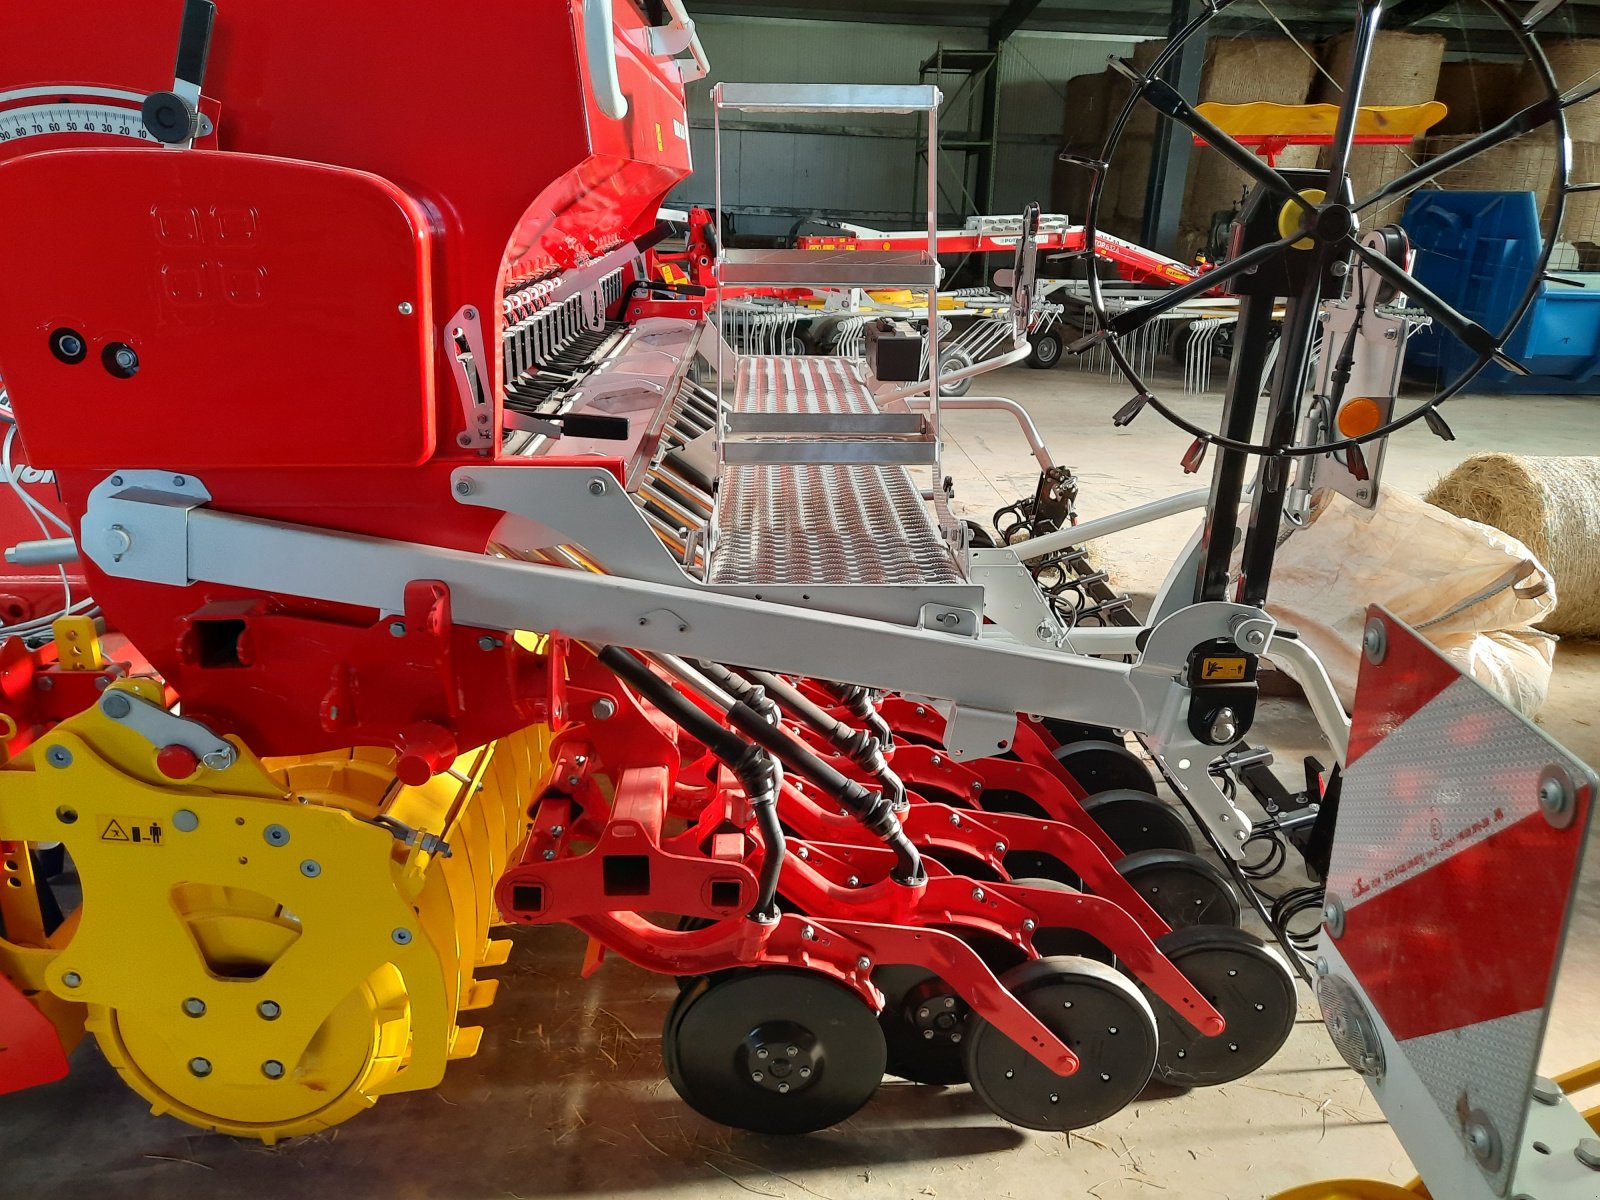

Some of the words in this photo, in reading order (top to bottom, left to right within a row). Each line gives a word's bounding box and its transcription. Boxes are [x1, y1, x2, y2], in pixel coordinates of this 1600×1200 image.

[0, 131, 11, 141] 90
[16, 127, 27, 137] 80
[32, 124, 43, 134] 70
[49, 122, 60, 132] 60
[66, 122, 78, 131] 50
[84, 122, 95, 132] 40
[101, 123, 113, 133] 30
[119, 126, 130, 136] 20
[138, 130, 147, 139] 10
